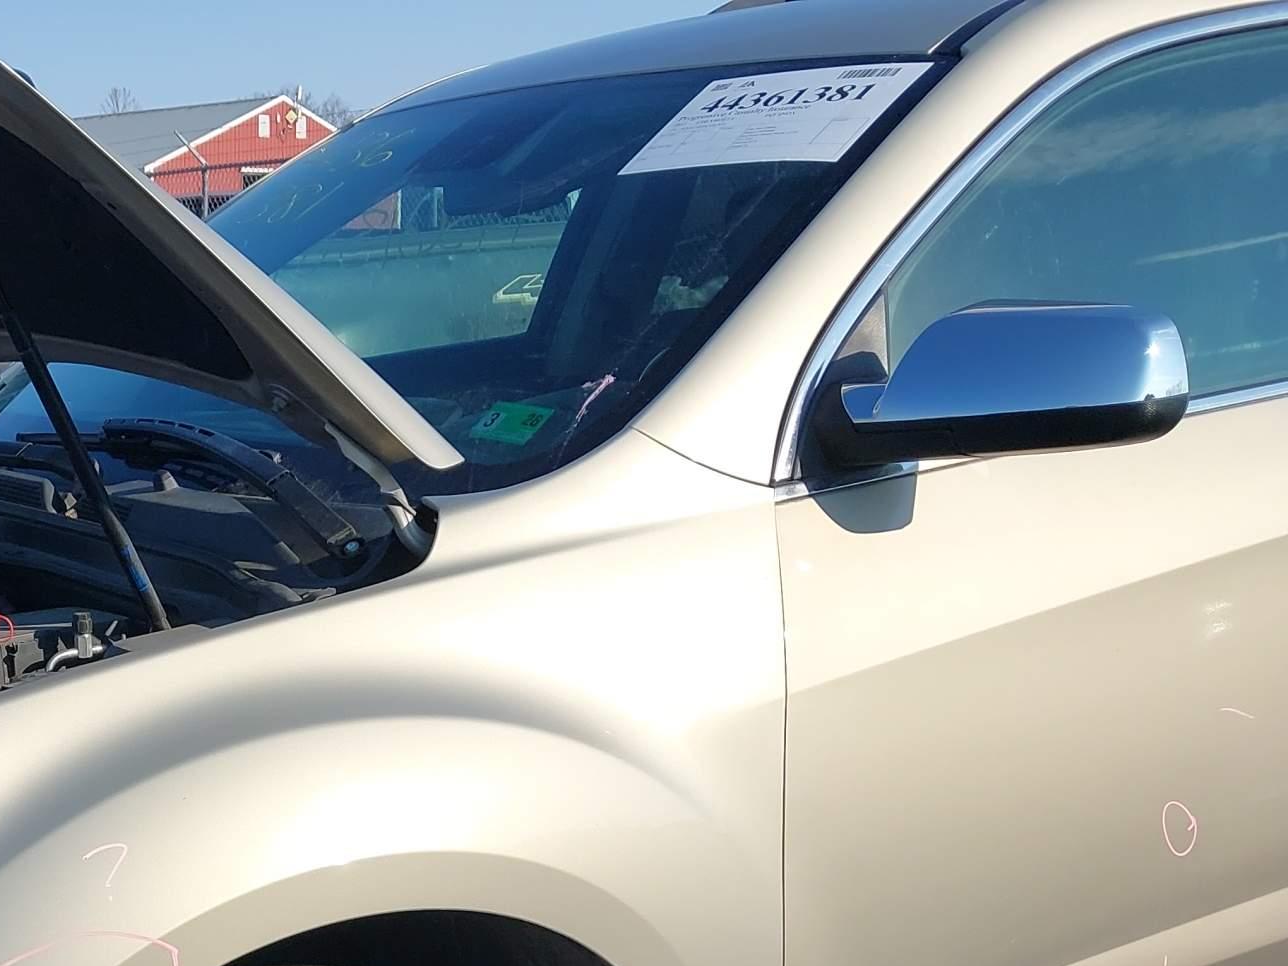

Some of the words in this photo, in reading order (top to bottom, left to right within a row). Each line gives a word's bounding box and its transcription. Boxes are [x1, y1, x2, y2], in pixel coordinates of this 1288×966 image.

[702, 83, 876, 113] 44361381
[483, 413, 500, 427] 3
[522, 412, 544, 427] 26
